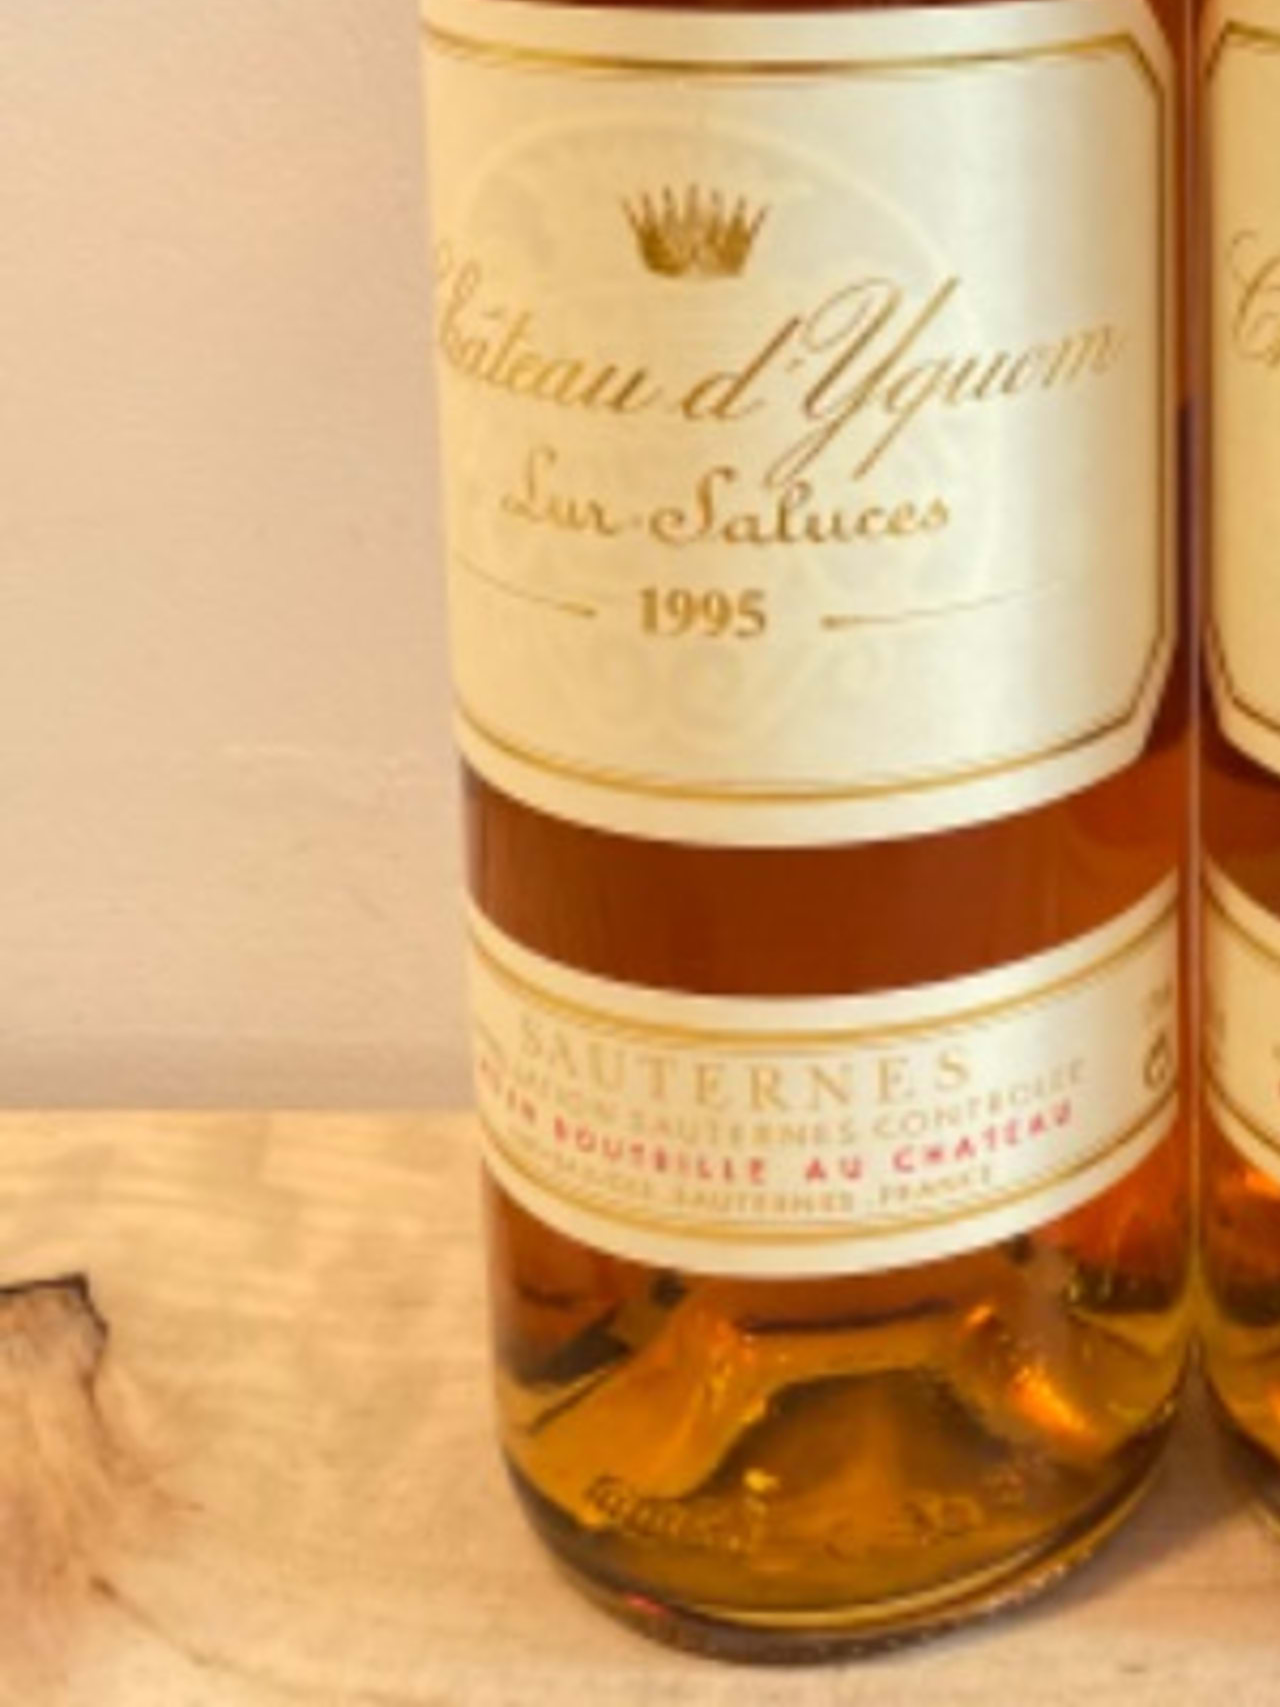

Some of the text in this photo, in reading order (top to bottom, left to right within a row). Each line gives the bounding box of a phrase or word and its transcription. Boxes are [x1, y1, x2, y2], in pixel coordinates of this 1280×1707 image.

[640, 586, 767, 639] 1995
[519, 1011, 972, 1113] SAUTERNES
[804, 1154, 864, 1186] AU
